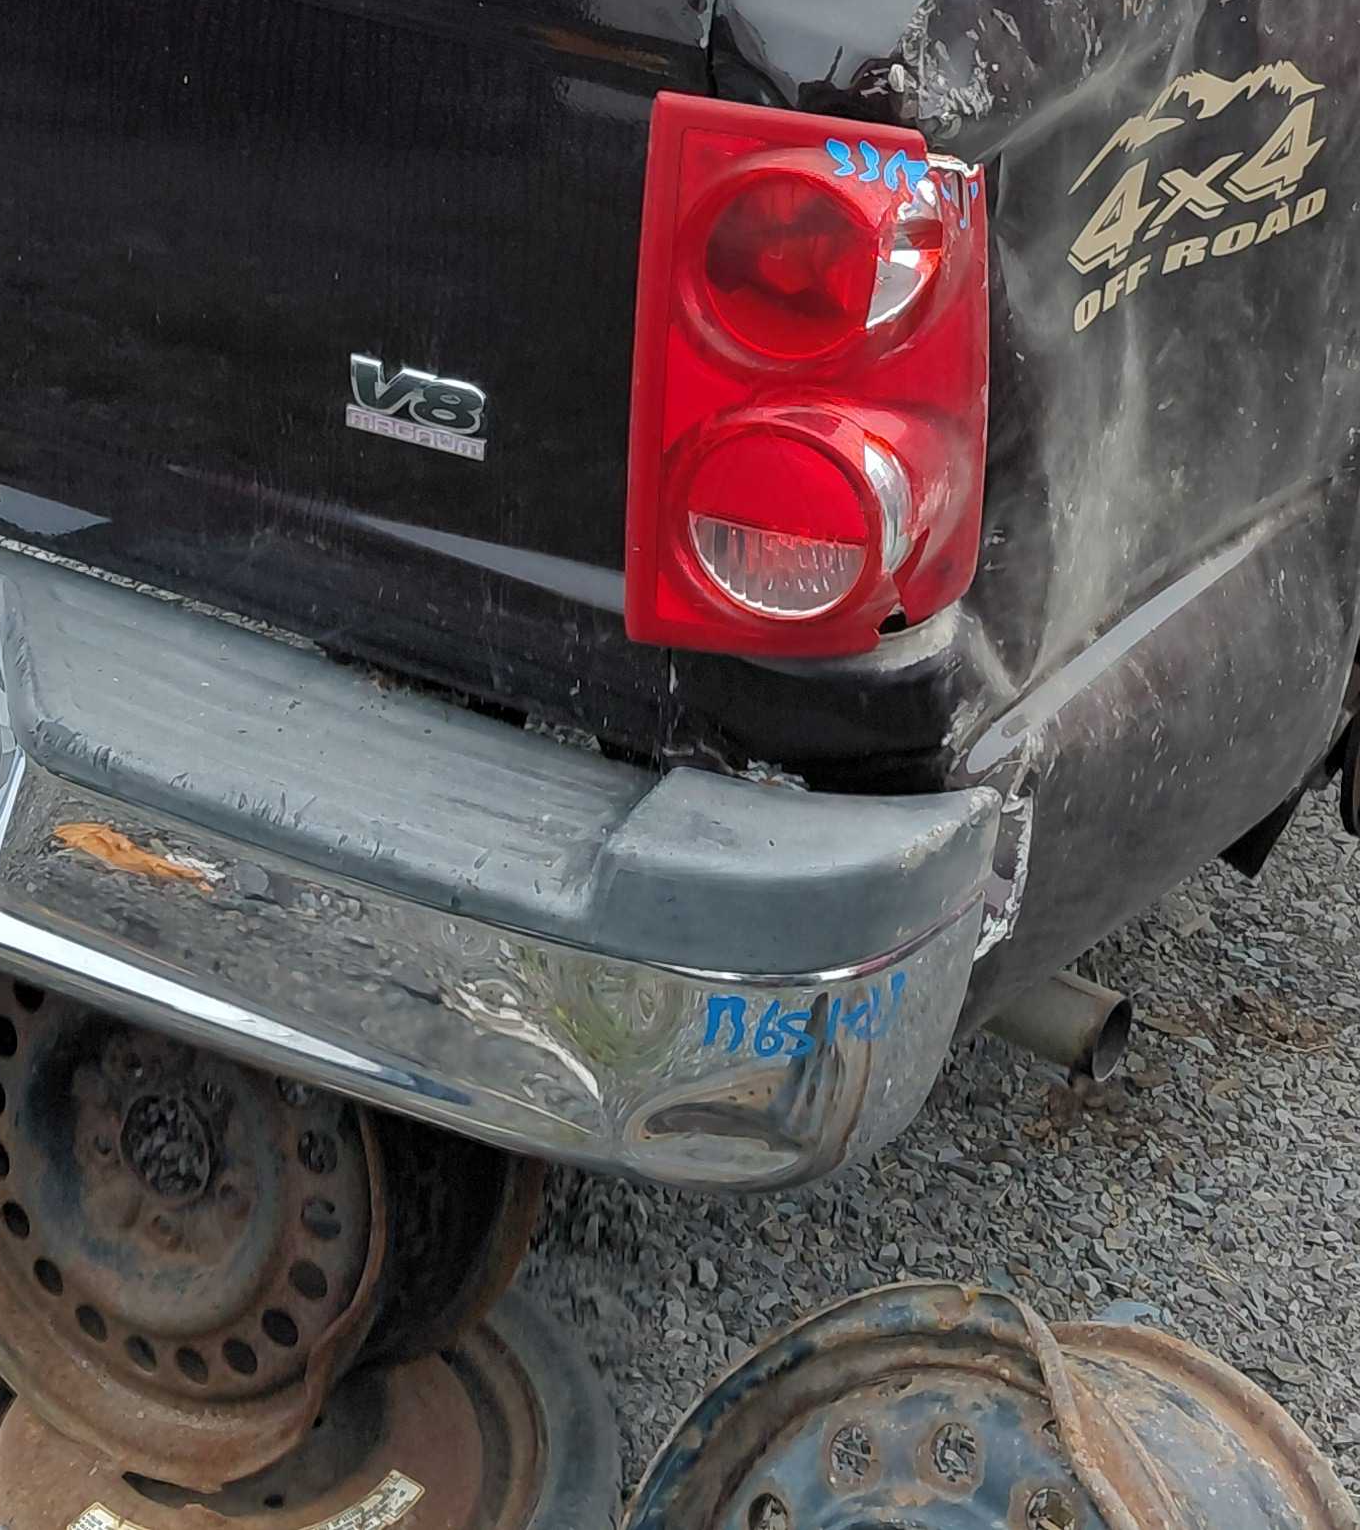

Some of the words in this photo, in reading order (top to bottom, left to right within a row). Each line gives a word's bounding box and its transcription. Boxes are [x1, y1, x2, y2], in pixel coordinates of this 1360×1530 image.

[1073, 254, 1152, 333] OFF
[1161, 187, 1327, 275] ROAD
[349, 352, 487, 436] V8
